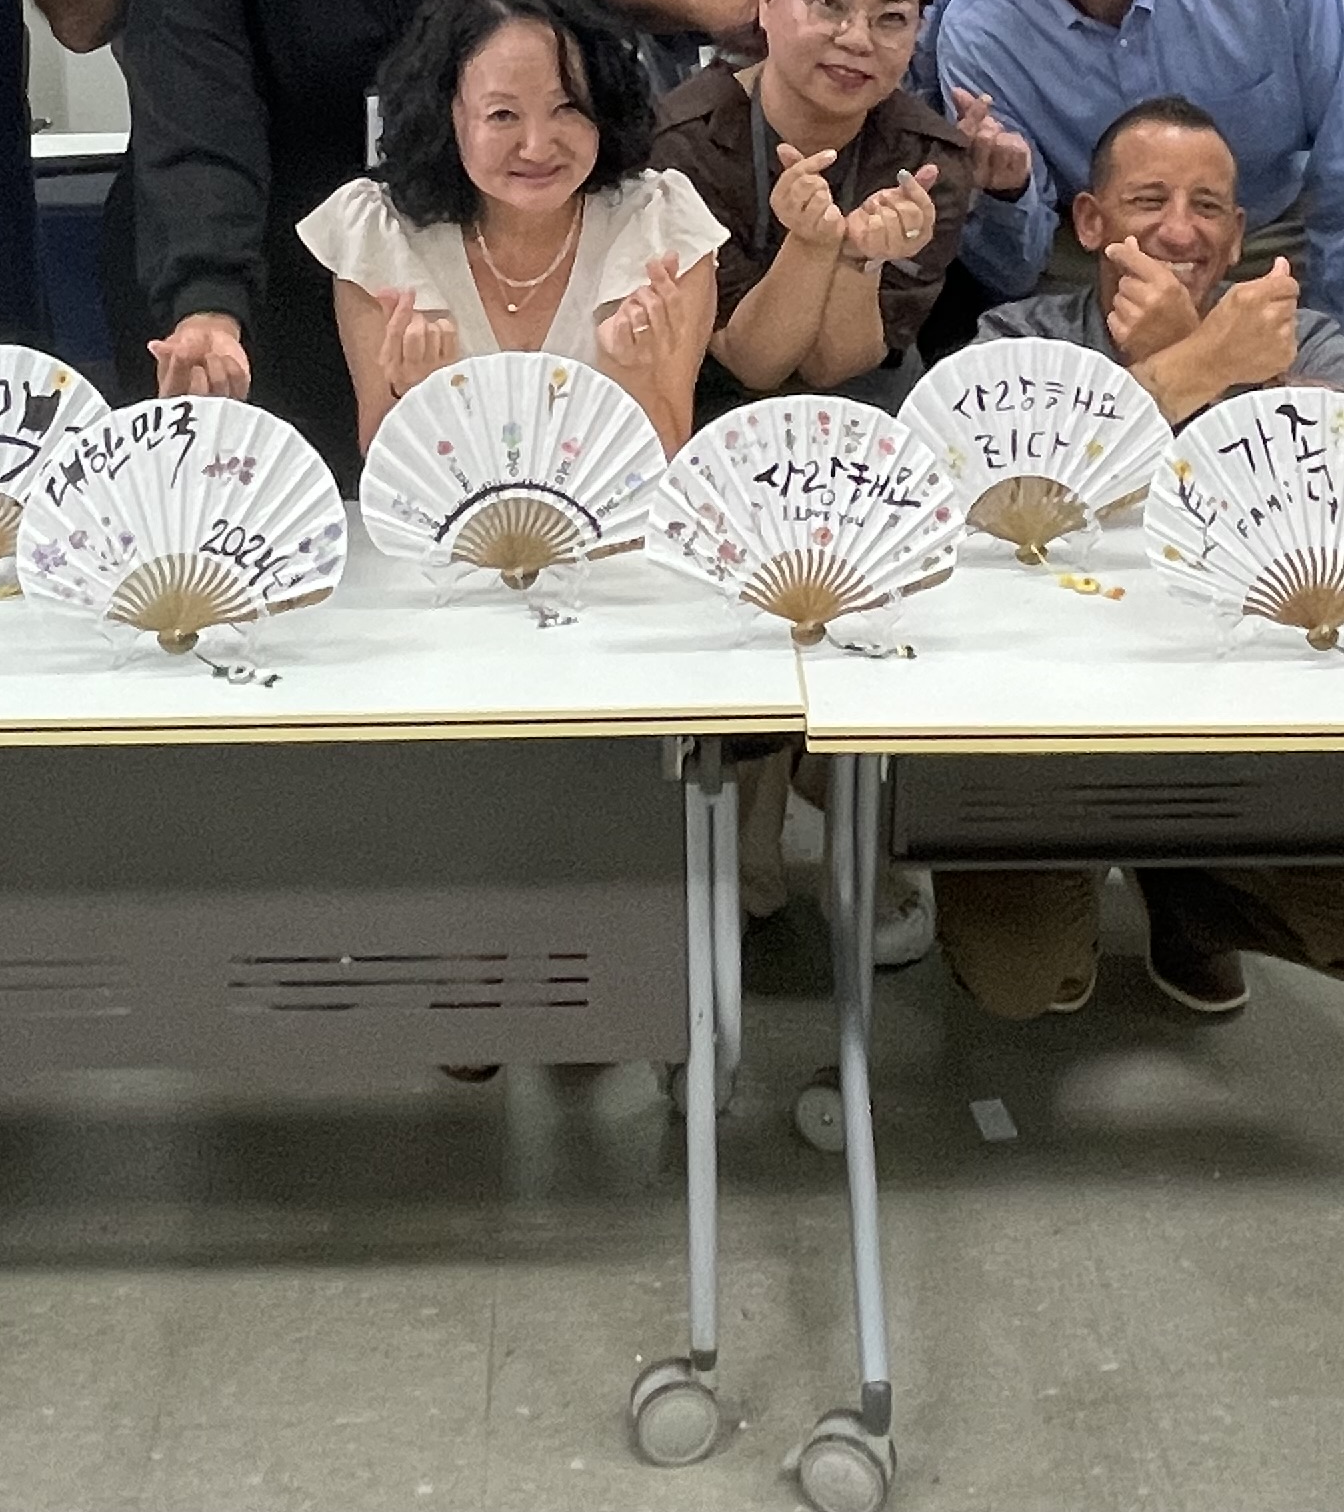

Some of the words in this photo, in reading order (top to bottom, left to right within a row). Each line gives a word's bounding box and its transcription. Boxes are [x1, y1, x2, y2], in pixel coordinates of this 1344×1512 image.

[952, 374, 1126, 421] 사랑해요
[43, 399, 199, 508] 대한민국
[752, 456, 922, 508] 사랑해요
[198, 517, 293, 588] 2024
